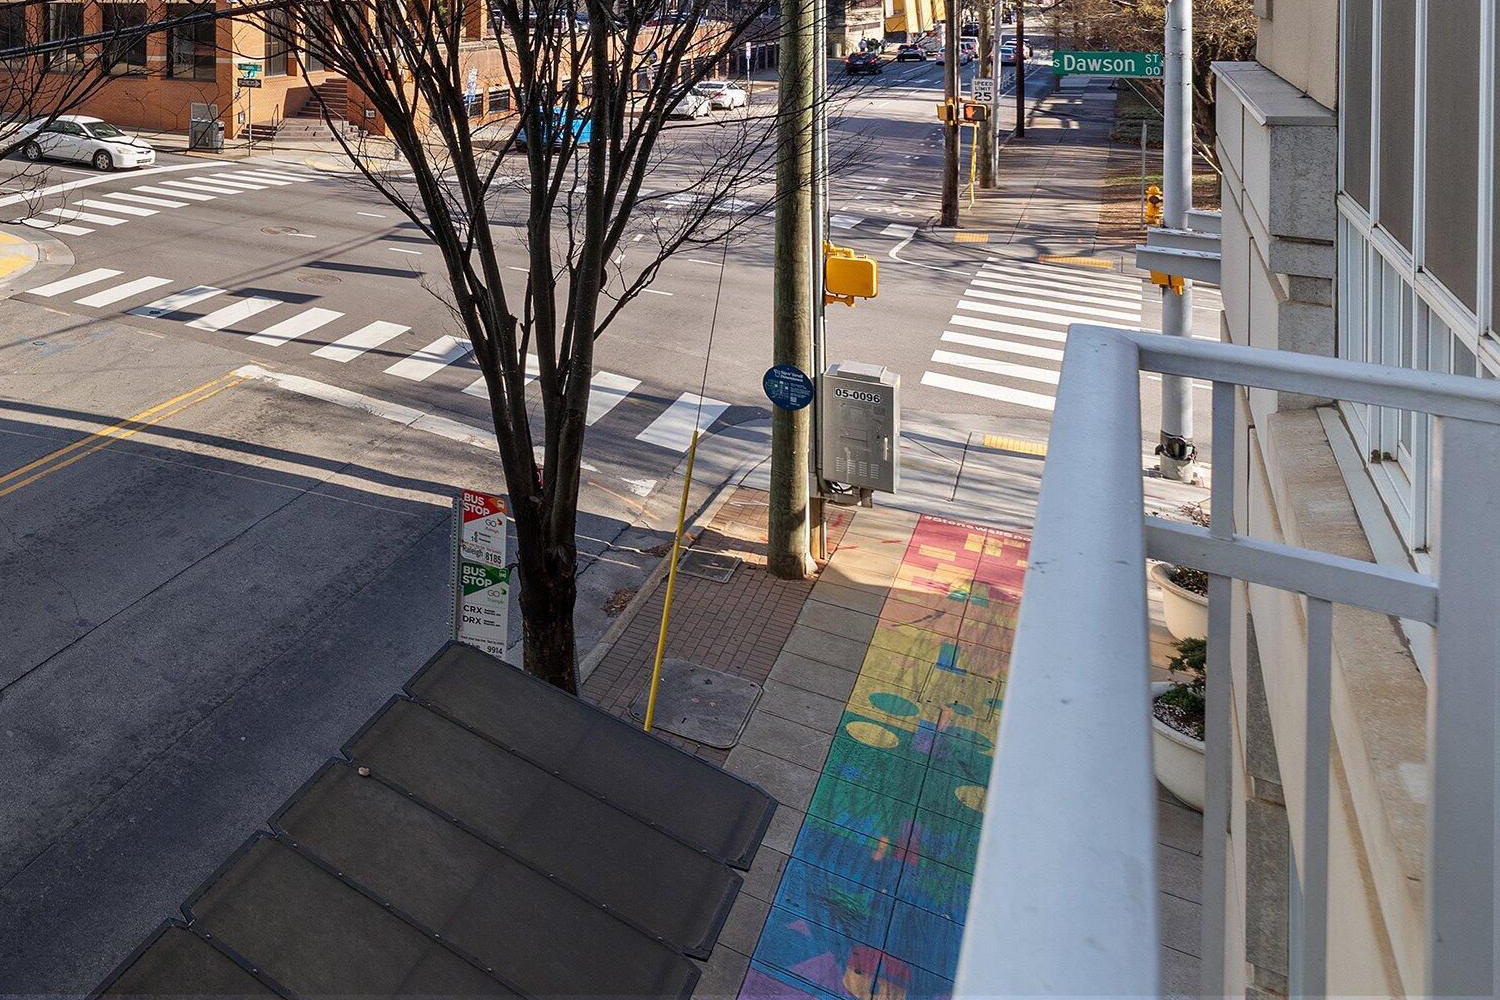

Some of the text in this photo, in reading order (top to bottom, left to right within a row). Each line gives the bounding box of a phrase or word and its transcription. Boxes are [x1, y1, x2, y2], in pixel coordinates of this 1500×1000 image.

[1063, 54, 1135, 72] Dawson
[1145, 54, 1159, 63] ST
[1145, 66, 1161, 76] 00
[974, 91, 992, 101] 25
[835, 388, 880, 403] 05-0096
[464, 493, 484, 506] BUS
[464, 502, 490, 516] STOP
[463, 565, 486, 578] BUS
[462, 575, 492, 587] STOP
[463, 604, 482, 614] CRX
[462, 615, 481, 625] DRX
[487, 645, 503, 655] 9914
